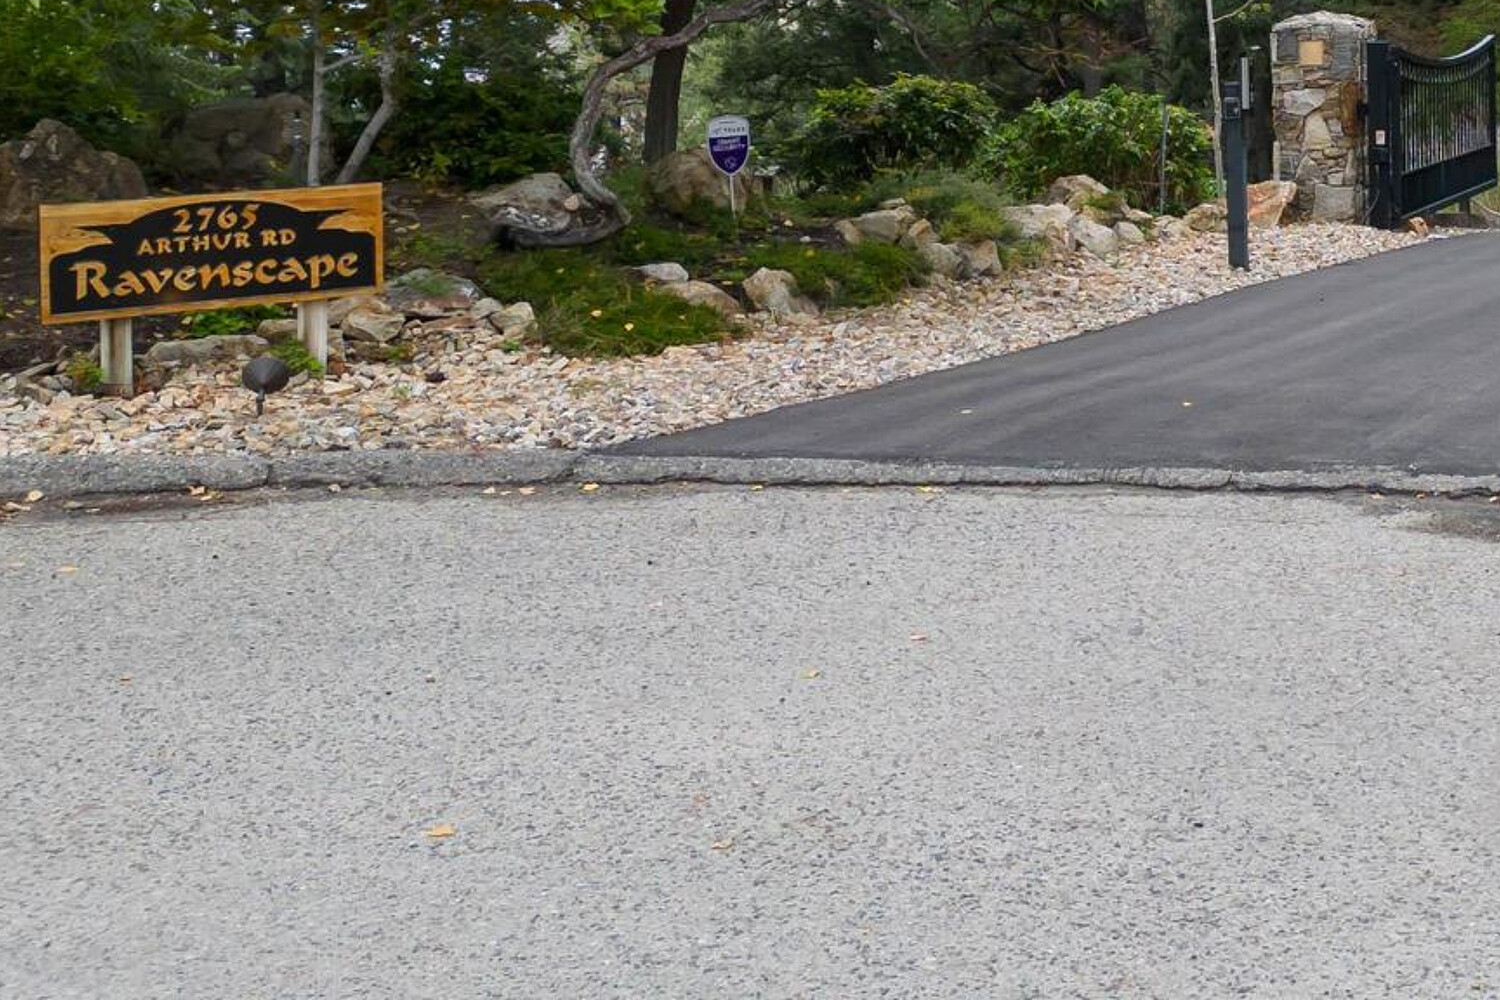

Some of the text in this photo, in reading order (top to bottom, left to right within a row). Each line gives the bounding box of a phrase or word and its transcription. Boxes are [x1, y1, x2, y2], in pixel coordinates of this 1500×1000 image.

[172, 203, 260, 233] 2765
[136, 228, 297, 256] ARTHUR RD
[68, 251, 359, 301] Ravenscape
